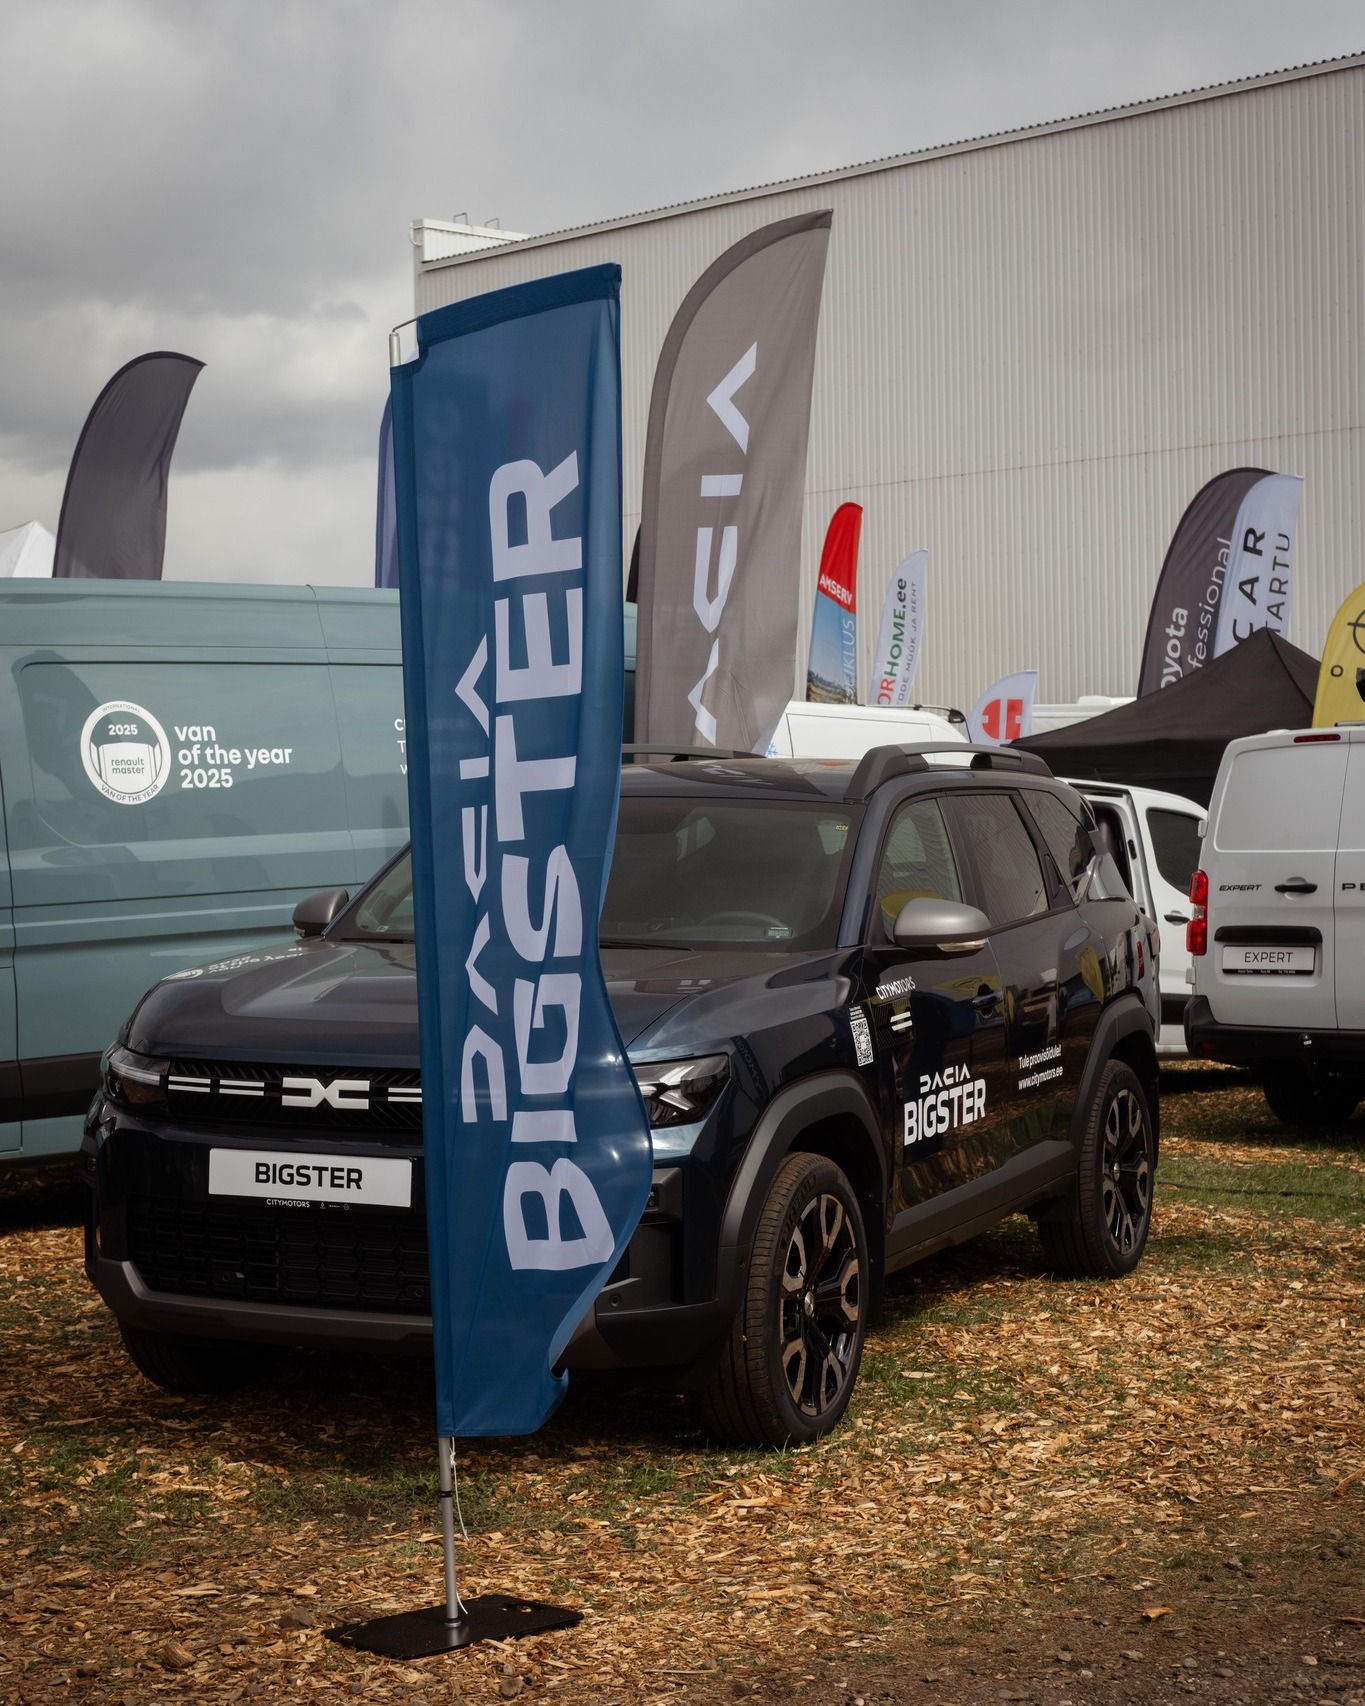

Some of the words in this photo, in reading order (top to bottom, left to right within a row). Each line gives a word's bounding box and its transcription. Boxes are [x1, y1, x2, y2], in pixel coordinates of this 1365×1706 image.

[819, 574, 852, 605] AMSERV
[1232, 527, 1266, 644] CAR
[906, 636, 916, 672] MÜÜK
[108, 724, 138, 735] 2025
[174, 725, 216, 741] van
[111, 757, 144, 766] renault
[178, 744, 201, 765] of
[204, 744, 241, 764] the
[244, 748, 293, 769] year
[112, 766, 144, 774] master
[180, 768, 233, 788] 2025
[101, 784, 115, 798] VAN
[116, 794, 126, 802] OF
[128, 794, 141, 802] THE
[143, 784, 159, 798] YEAR
[489, 450, 615, 1271] BIGSTER
[1244, 952, 1294, 963] EXPERT
[875, 976, 916, 1000] CITYMOTORS
[1018, 1054, 1029, 1069] Tule
[920, 1063, 970, 1094] DACIA
[1018, 1066, 1063, 1090] www.citymotors.ee
[903, 1078, 986, 1146] BIGSTER
[255, 1162, 362, 1190] BIGSTER
[266, 1198, 310, 1208] CITYMOTORS
